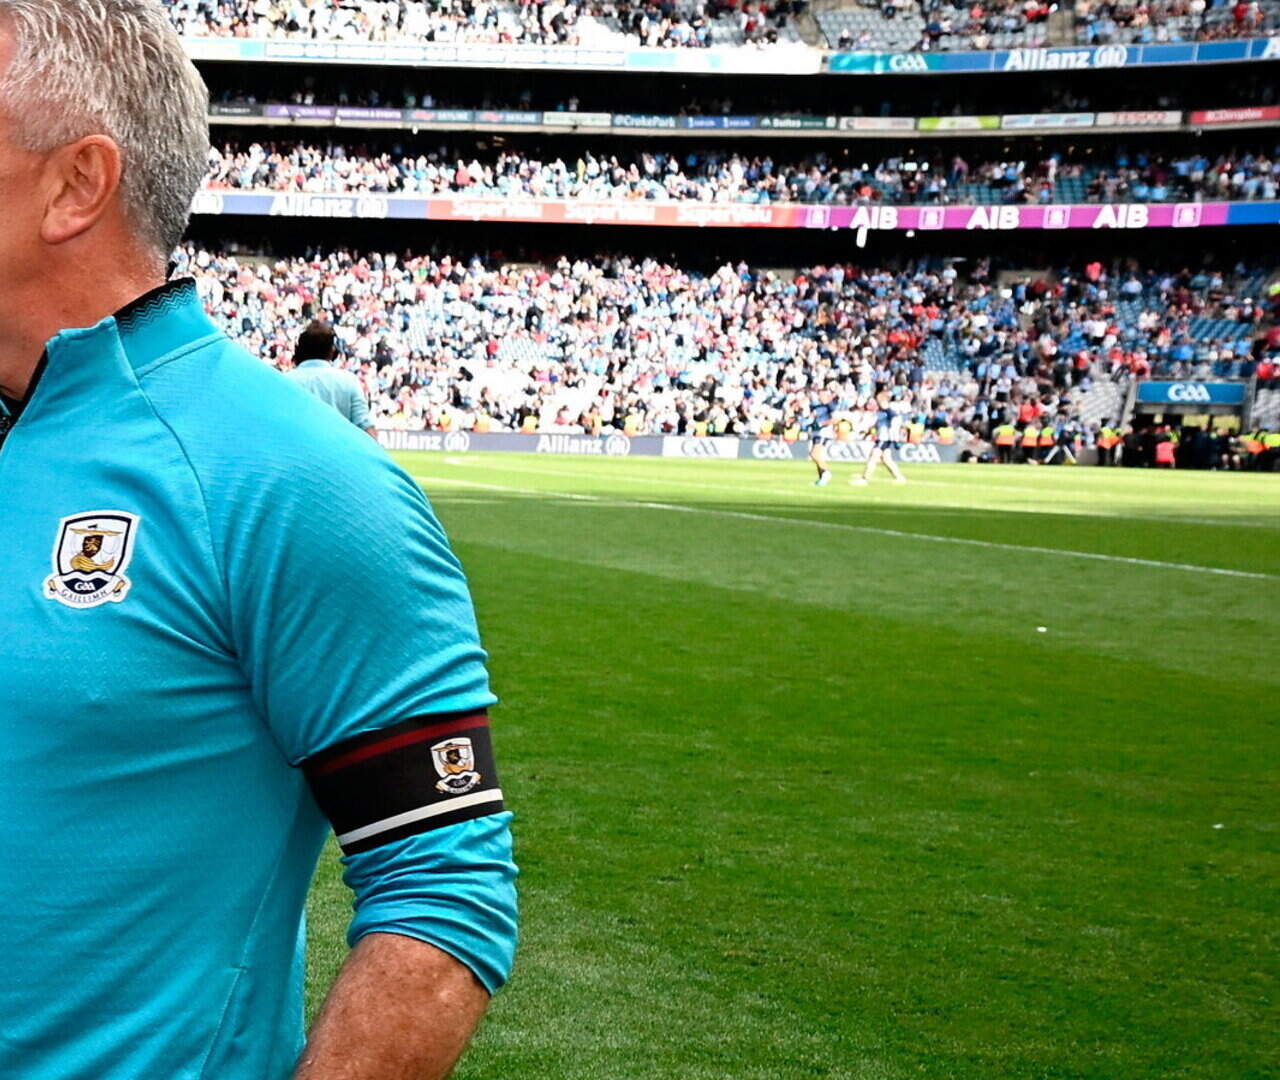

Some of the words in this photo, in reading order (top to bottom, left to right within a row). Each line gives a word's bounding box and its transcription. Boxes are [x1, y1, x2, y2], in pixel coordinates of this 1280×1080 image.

[1004, 48, 1091, 71] Allianz
[269, 195, 354, 217] Allianz
[452, 199, 541, 219] SuperValu
[564, 202, 655, 223] SuperValu
[677, 203, 772, 225] SuperValu
[1092, 204, 1149, 229] AIB
[849, 207, 898, 229] AIB
[967, 205, 1019, 230] AIB
[378, 431, 441, 450] Allianz
[537, 435, 603, 455] Allianz
